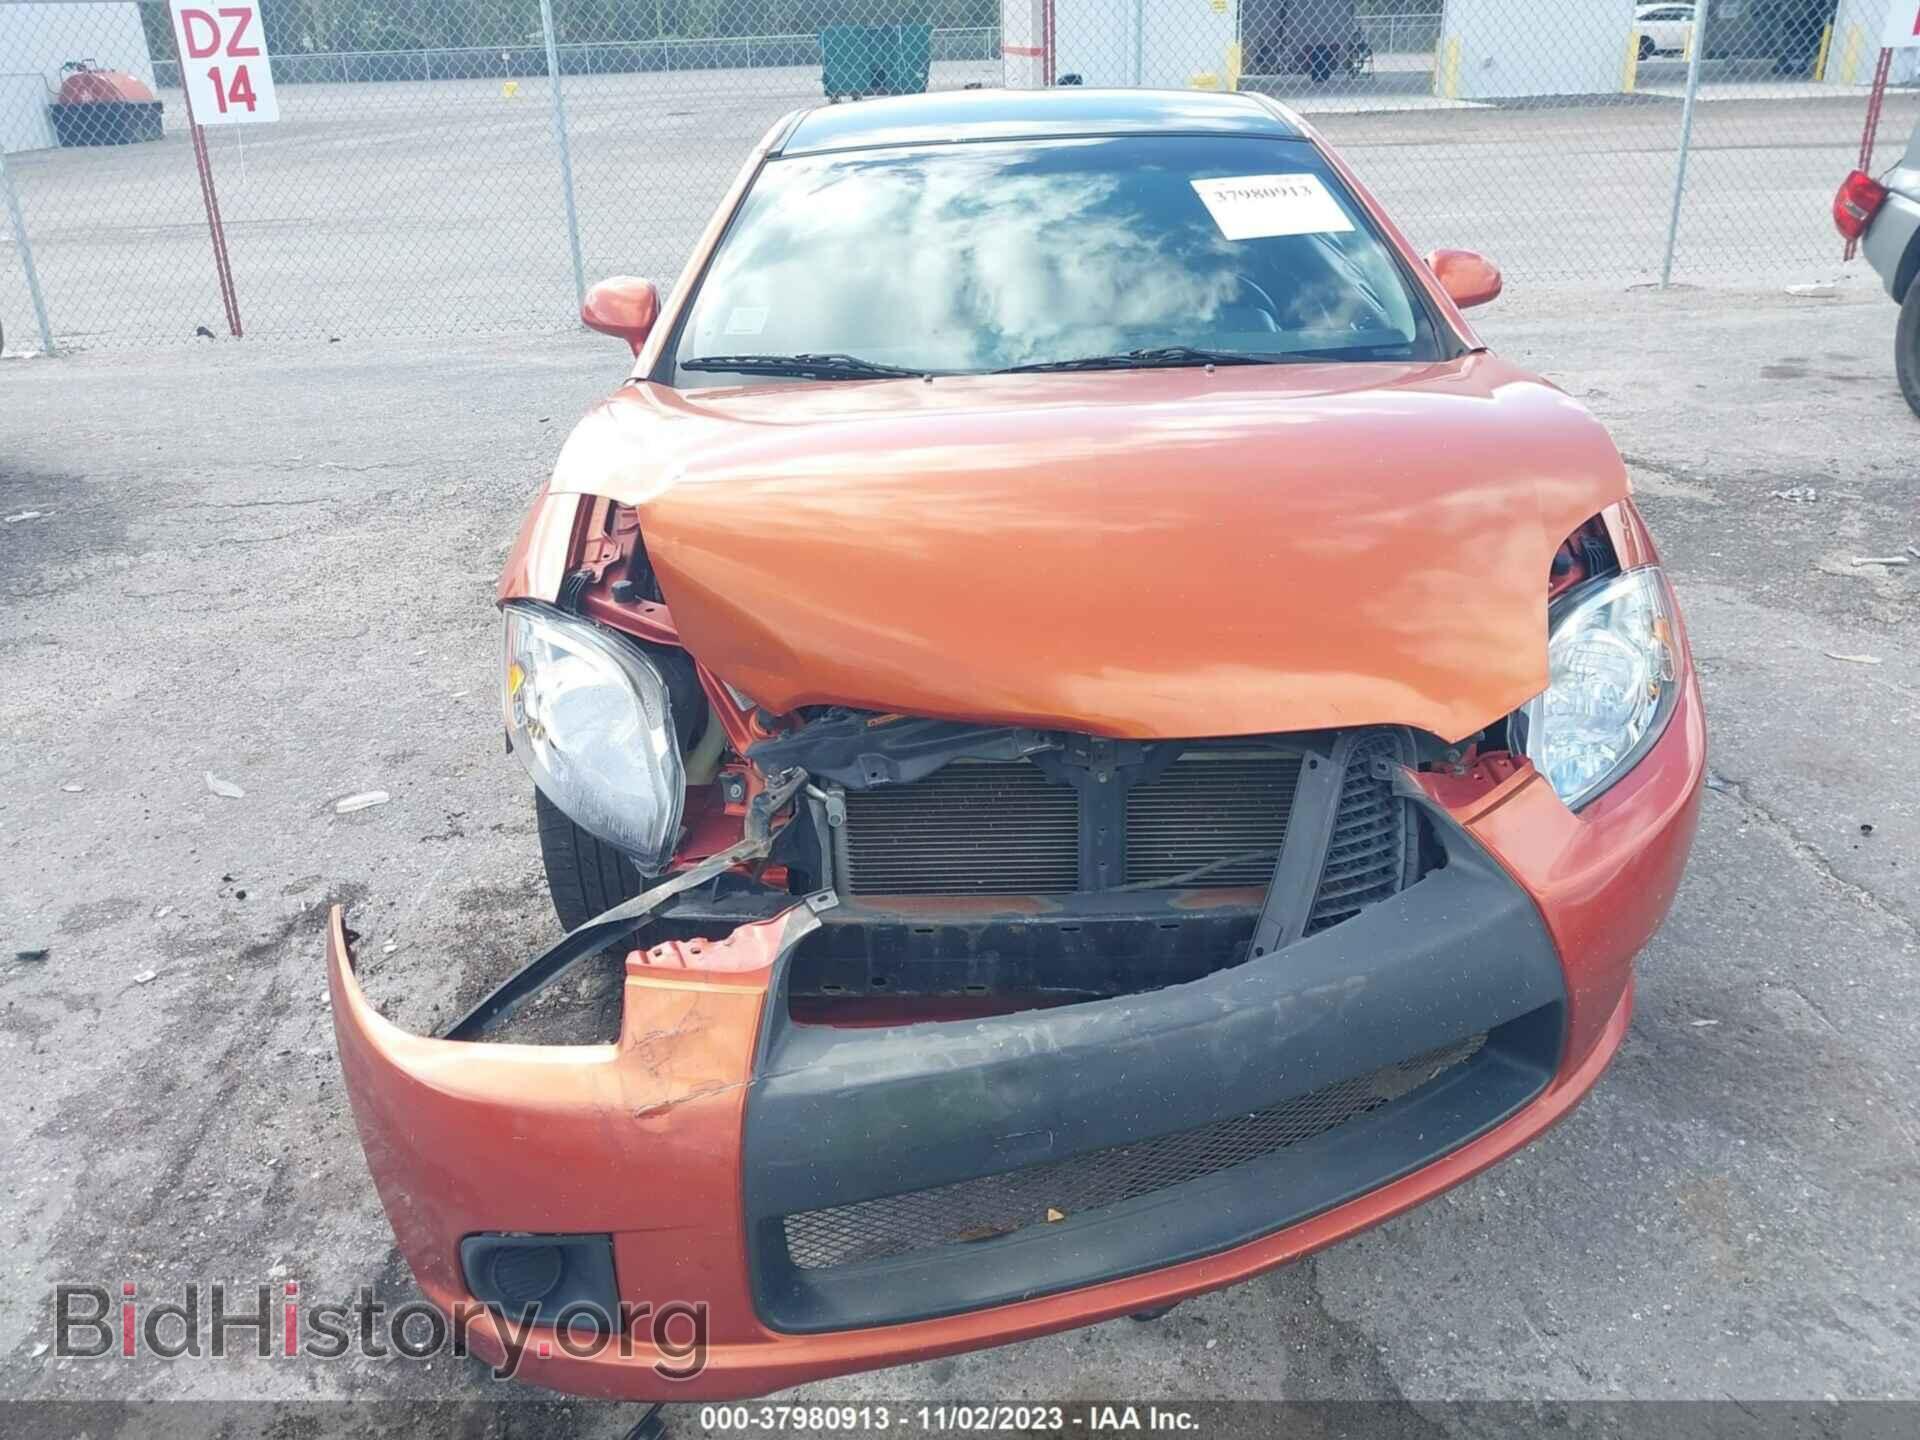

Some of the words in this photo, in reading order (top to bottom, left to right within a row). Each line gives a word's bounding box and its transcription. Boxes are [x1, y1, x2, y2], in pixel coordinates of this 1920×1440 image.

[180, 8, 260, 58] DZ
[207, 64, 257, 113] 14
[1214, 185, 1313, 202] 37980913
